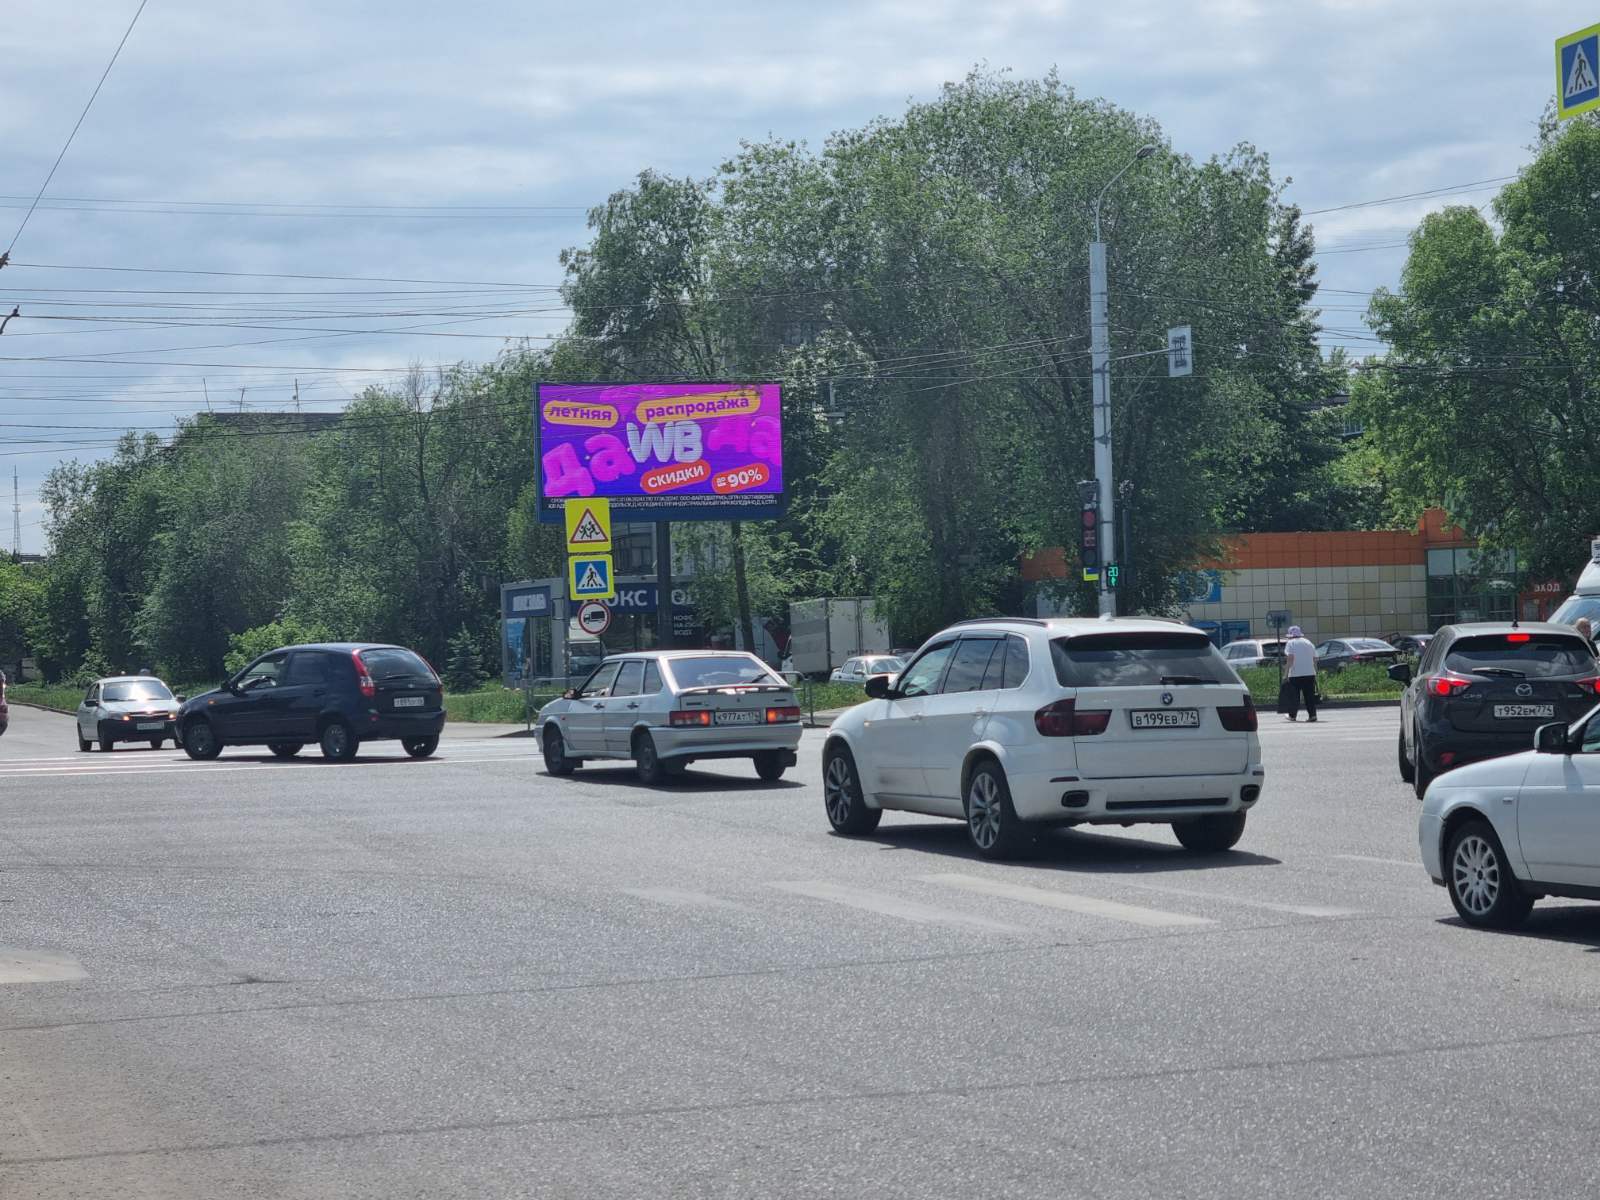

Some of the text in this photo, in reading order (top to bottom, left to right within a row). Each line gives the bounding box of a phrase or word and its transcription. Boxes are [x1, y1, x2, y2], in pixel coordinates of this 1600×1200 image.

[549, 405, 612, 421] летняя
[645, 396, 750, 420] распродажа
[626, 420, 703, 463] WB
[727, 468, 763, 488] 90%
[1108, 566, 1119, 577] 20
